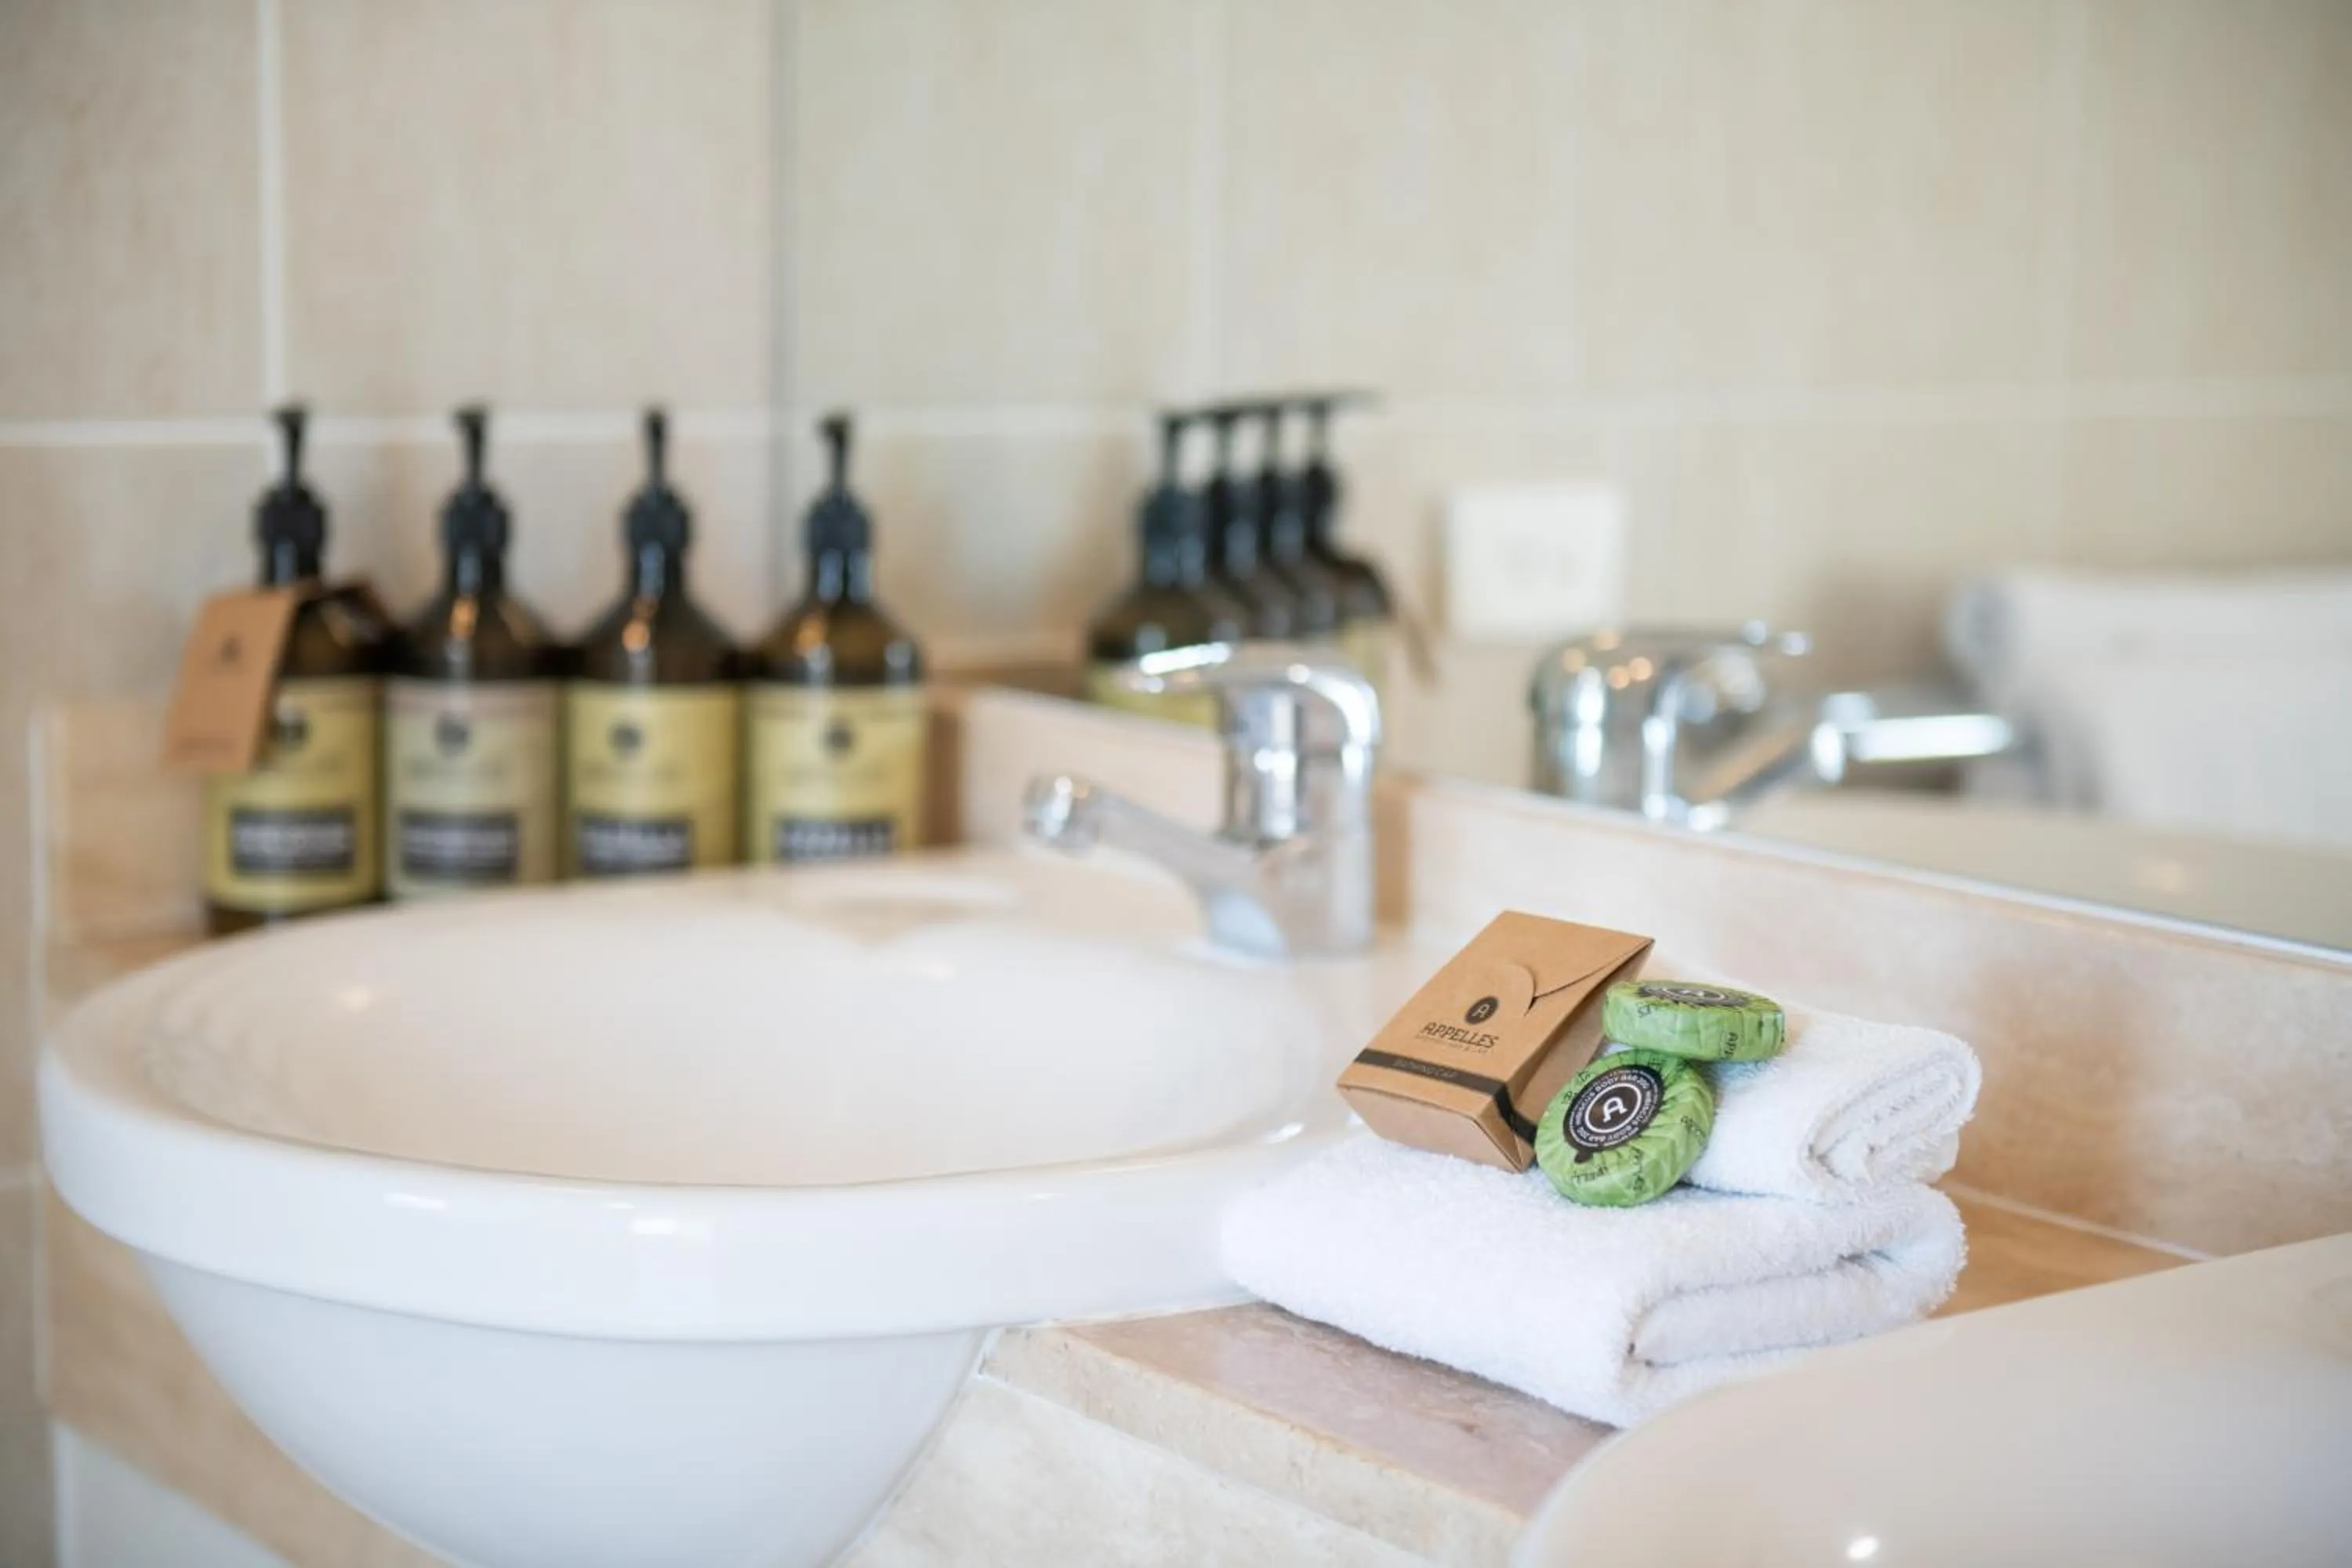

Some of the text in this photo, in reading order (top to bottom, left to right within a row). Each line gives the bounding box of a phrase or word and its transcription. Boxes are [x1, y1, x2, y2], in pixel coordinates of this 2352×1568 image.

[1420, 1022, 1495, 1049] APPELLES
[1595, 1076, 1619, 1092] BODY
[1602, 1096, 1628, 1123] A
